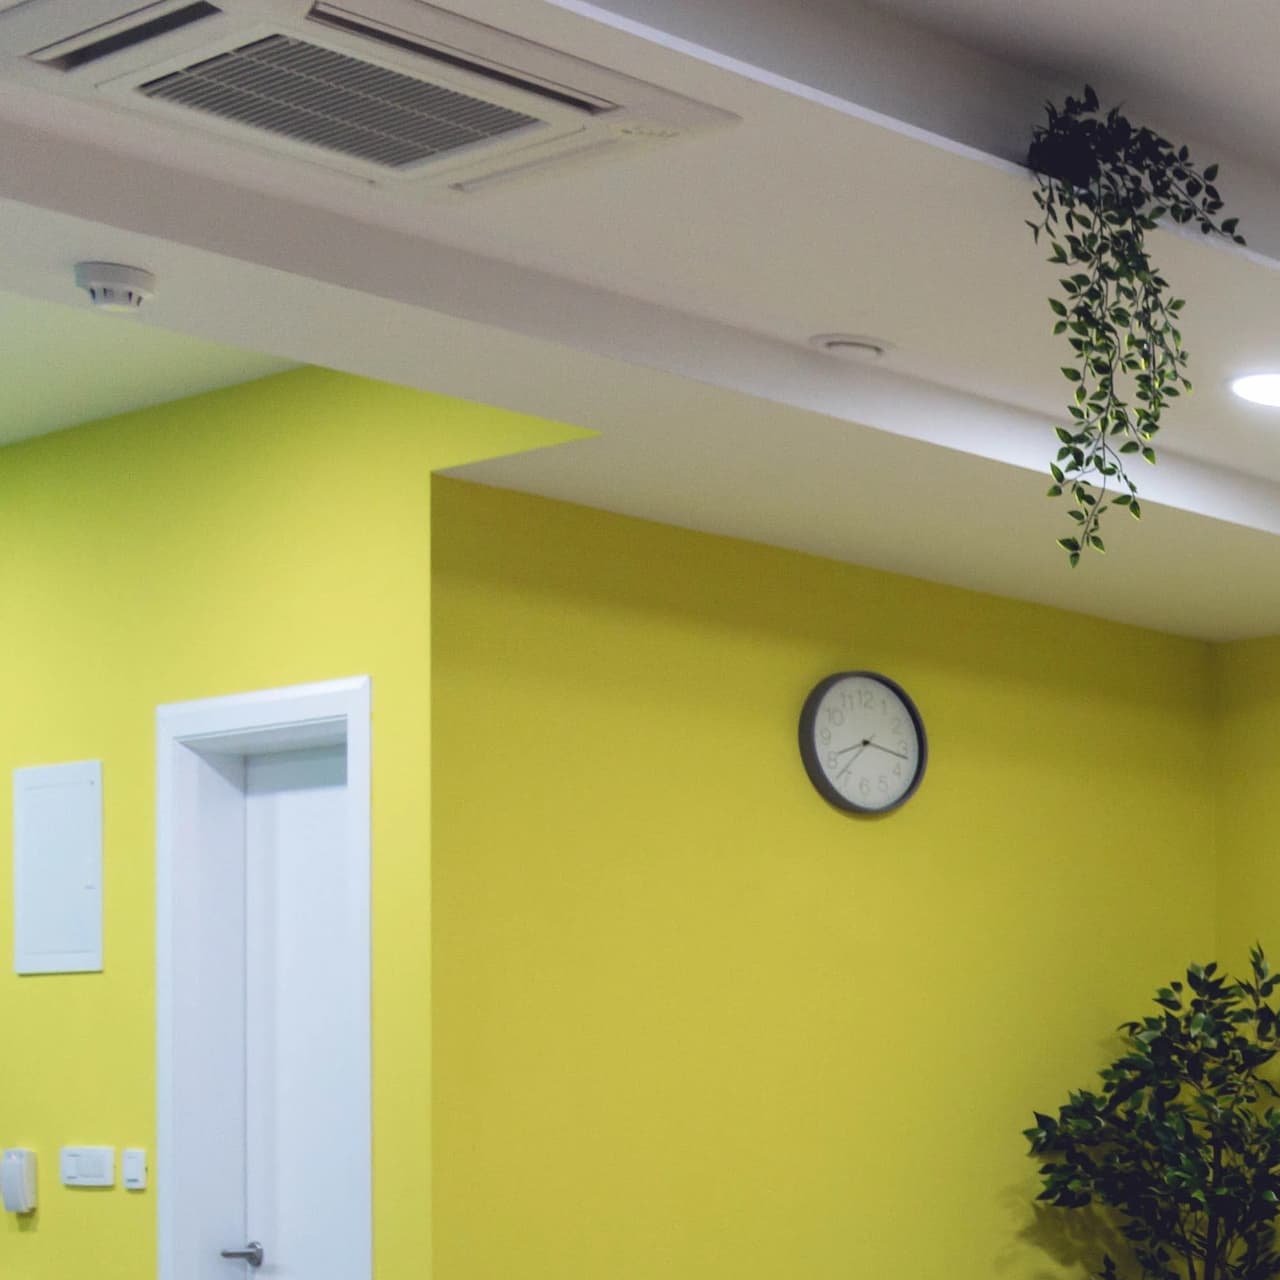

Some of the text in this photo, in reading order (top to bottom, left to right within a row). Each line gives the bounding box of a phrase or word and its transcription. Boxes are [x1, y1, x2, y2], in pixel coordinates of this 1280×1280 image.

[840, 693, 854, 710] 11
[857, 689, 875, 709] 12
[827, 707, 844, 726] 10
[881, 701, 887, 715] 1
[892, 718, 901, 735] 2
[820, 728, 831, 745] 9
[828, 751, 838, 769] 8
[893, 762, 901, 776] 4
[859, 777, 871, 796] 6
[878, 776, 888, 791] 5
